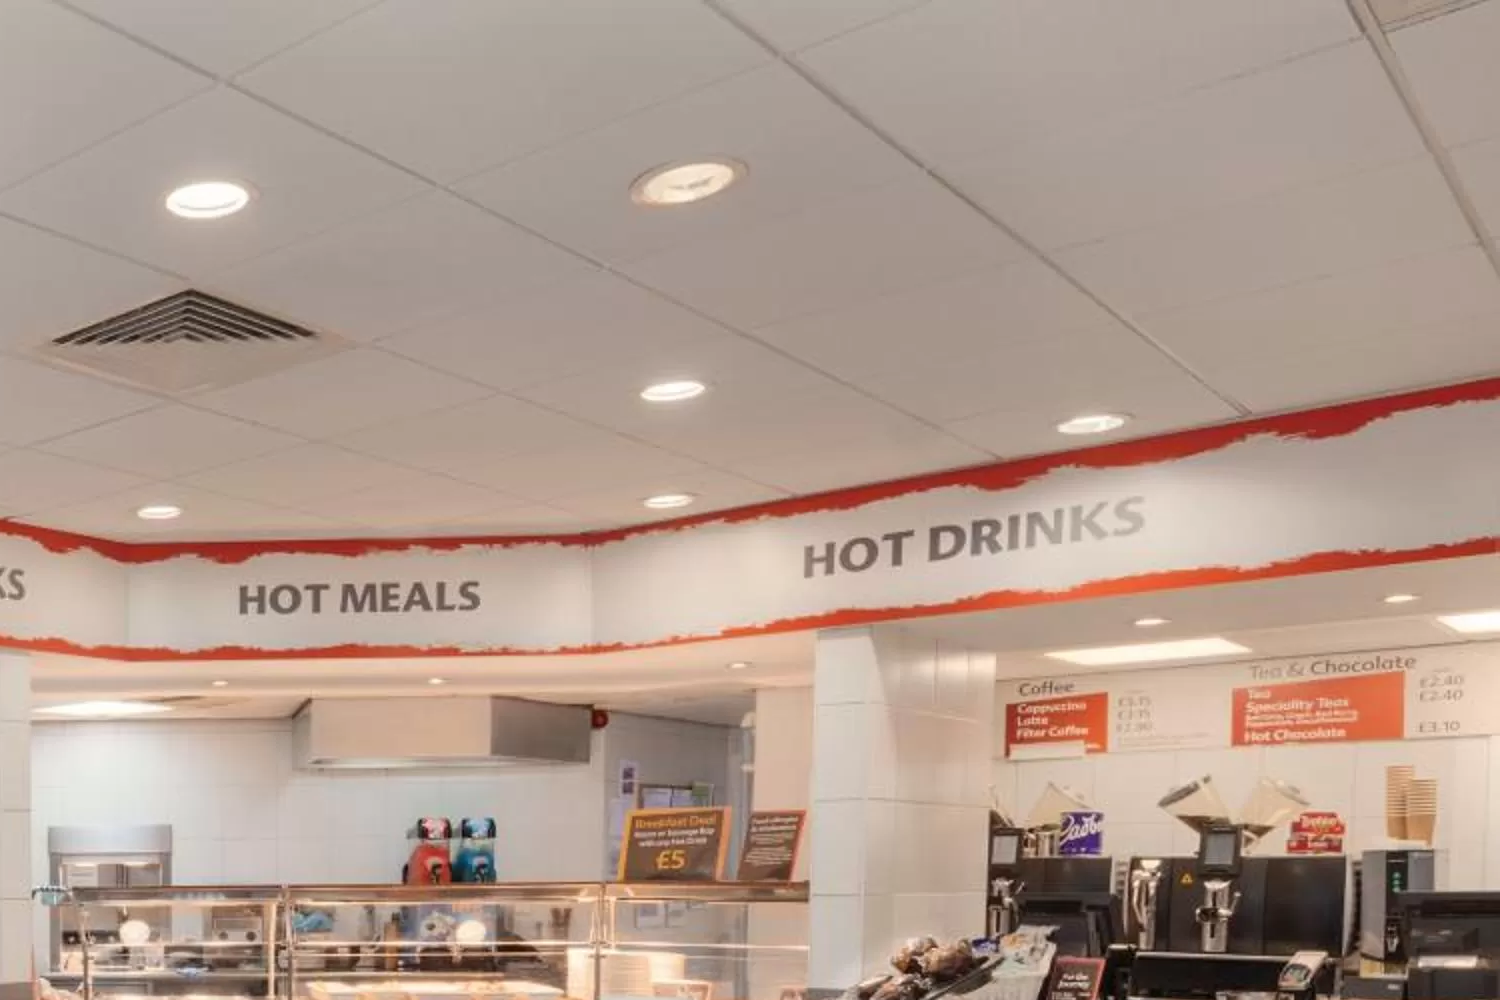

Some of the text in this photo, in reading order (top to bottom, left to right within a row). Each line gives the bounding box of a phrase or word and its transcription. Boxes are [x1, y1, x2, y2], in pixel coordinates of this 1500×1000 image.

[803, 496, 1145, 578] HOT DRINKS
[239, 580, 481, 614] HOT MEALS
[1252, 665, 1282, 680] Tea
[1286, 661, 1305, 677] &
[1310, 655, 1417, 675] Chocolate
[1016, 680, 1075, 698] Coffee
[1016, 702, 1088, 715] Cappuccino
[1016, 715, 1049, 727] Latte
[1047, 724, 1089, 738] Coffee
[1244, 726, 1348, 744] Hot Chocolate
[655, 849, 686, 870] £5
